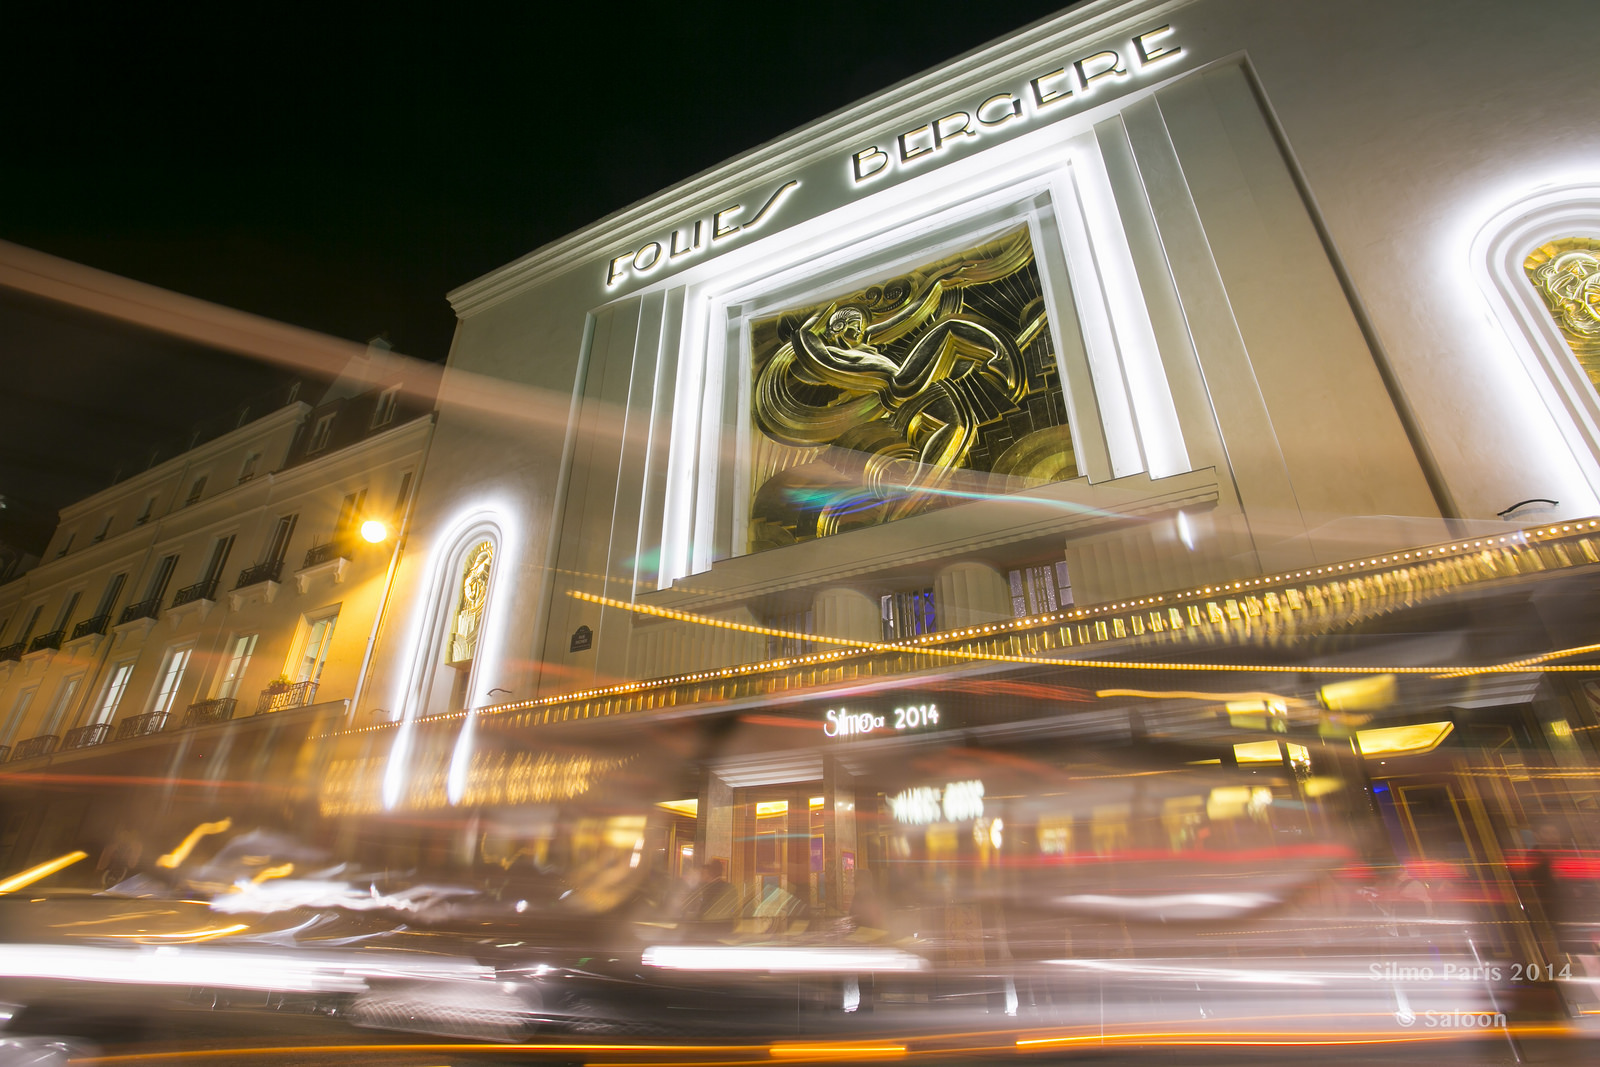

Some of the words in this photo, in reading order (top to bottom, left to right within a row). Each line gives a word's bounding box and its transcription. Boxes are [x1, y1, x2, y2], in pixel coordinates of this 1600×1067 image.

[606, 179, 798, 286] FOLIES
[852, 23, 1182, 183] BERGERE
[894, 704, 939, 729] 2014
